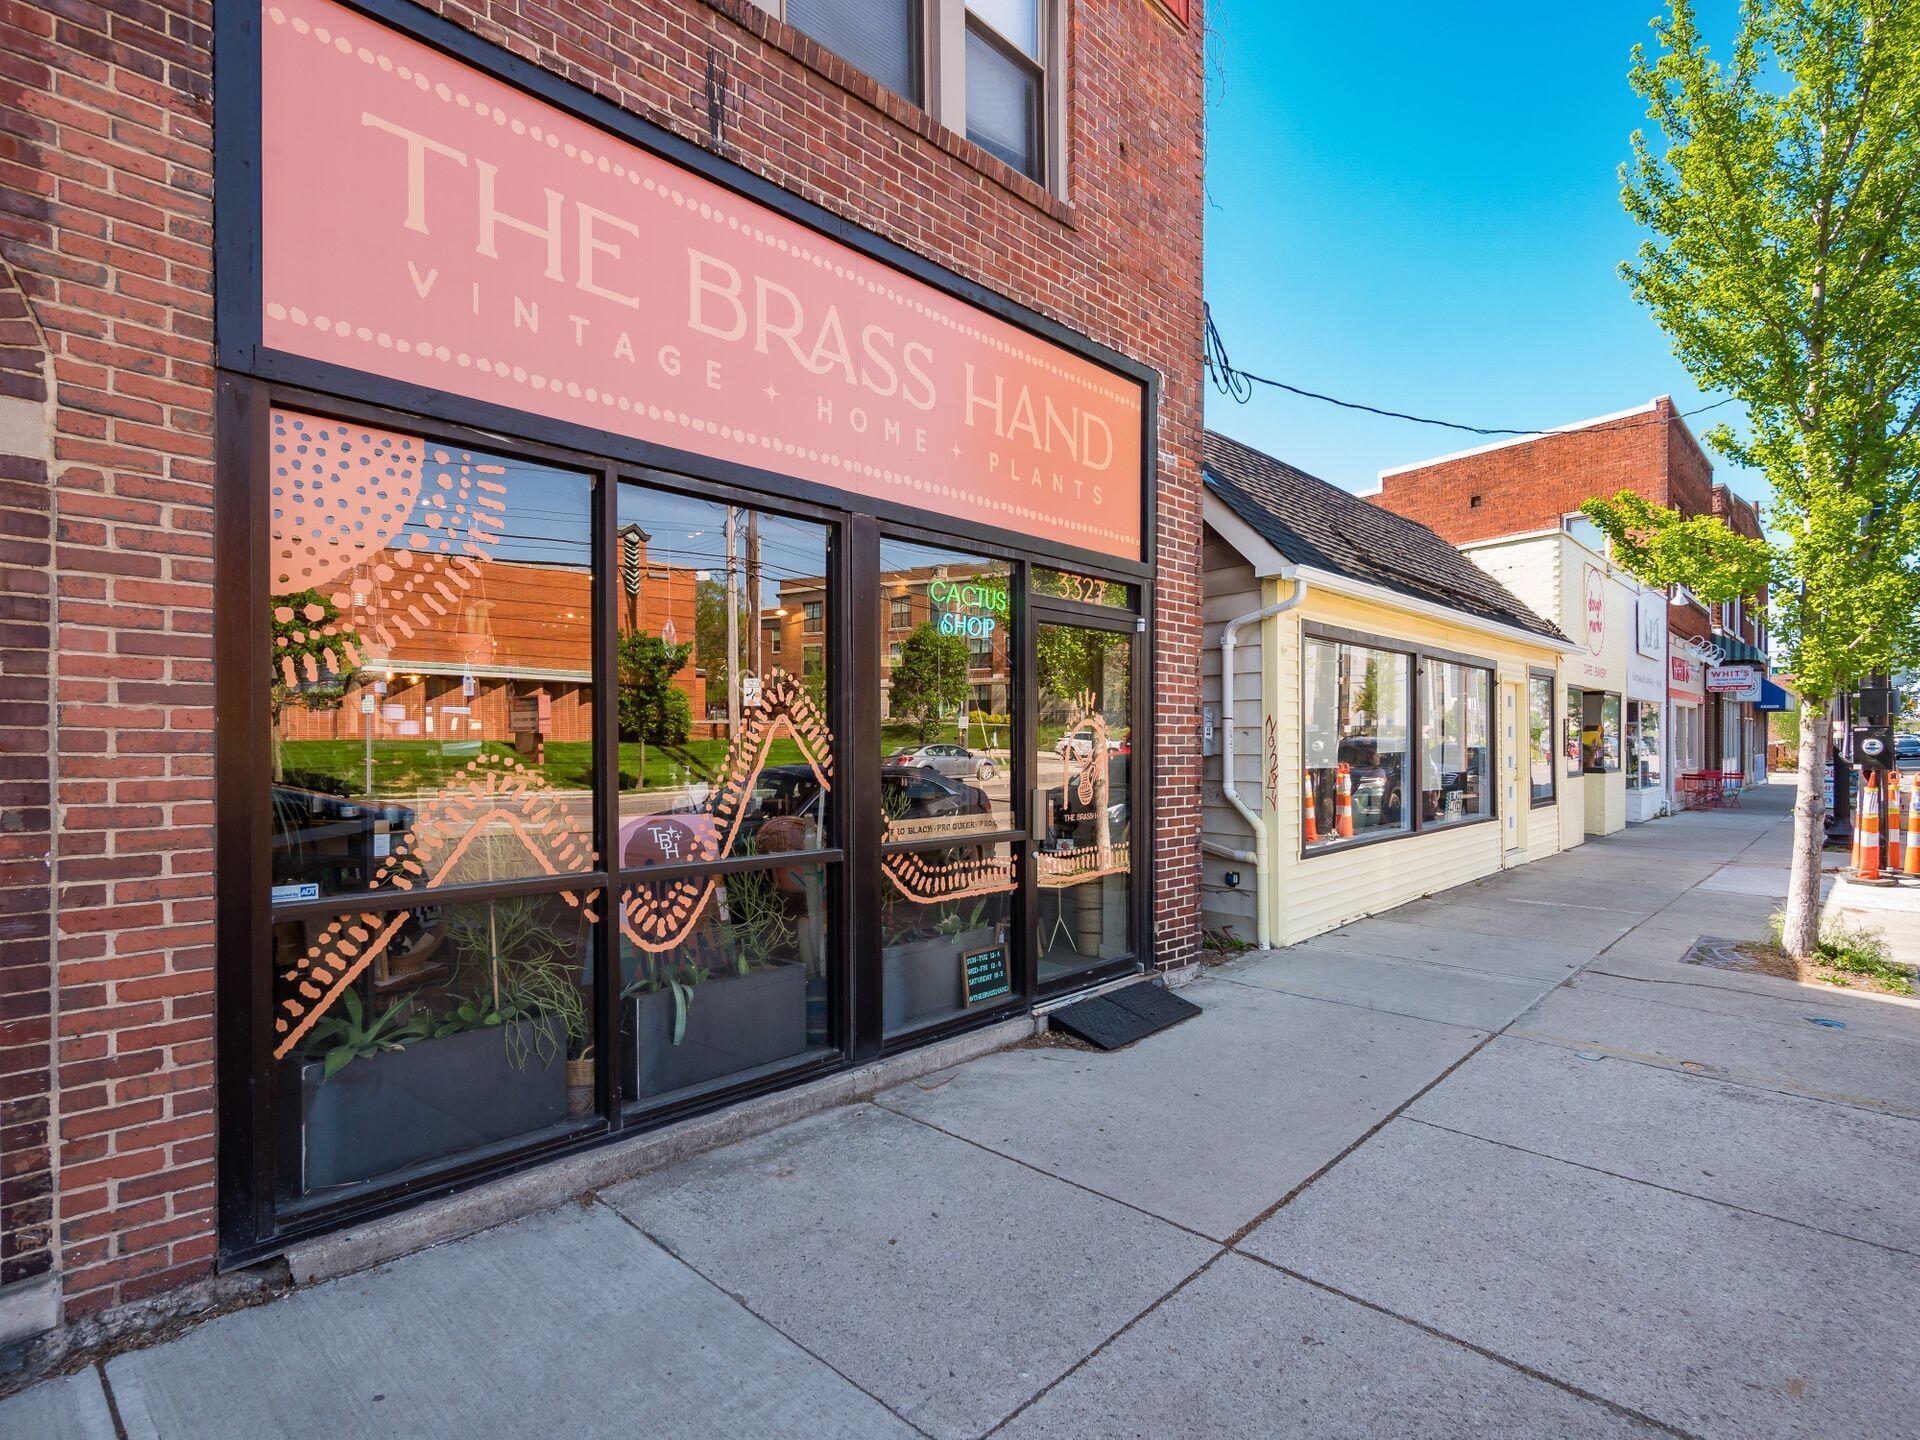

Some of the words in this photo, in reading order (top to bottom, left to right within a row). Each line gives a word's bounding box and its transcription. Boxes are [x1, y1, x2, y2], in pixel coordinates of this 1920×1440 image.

[361, 111, 639, 309] THE
[687, 247, 936, 411] BRASS
[964, 362, 1113, 471] HAND
[407, 260, 722, 391] VINTAGE
[817, 396, 927, 453] HOME
[989, 451, 1103, 505] PLANTS
[929, 579, 1007, 611] CACTUS
[1057, 572, 1106, 606] 3327
[941, 612, 995, 638] SHOP
[1711, 670, 1749, 678] WHIT'S
[907, 824, 933, 836] BLACK
[952, 821, 975, 831] QUEER
[1064, 813, 1076, 822] THE
[1076, 812, 1094, 821] BRASS
[647, 826, 680, 860] TBH
[301, 887, 316, 896] ADT
[968, 973, 993, 986] SATURDAY
